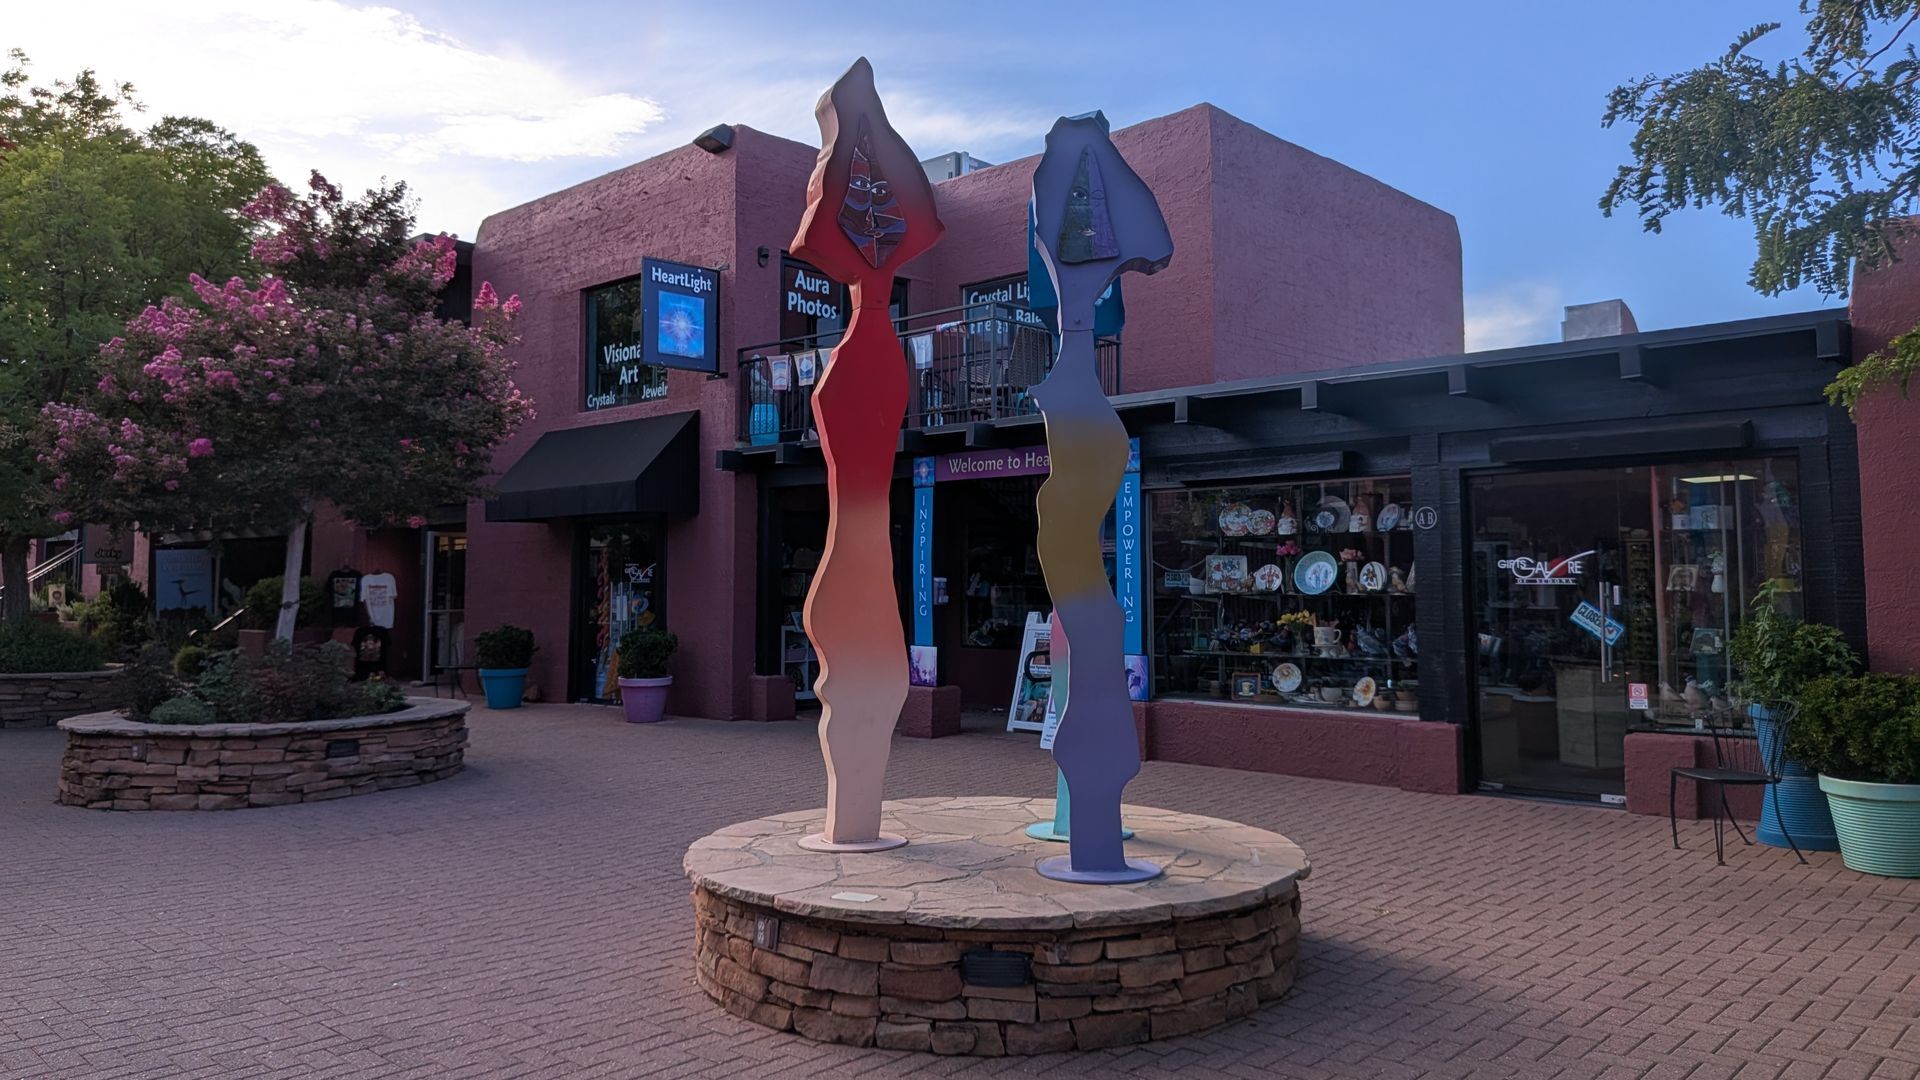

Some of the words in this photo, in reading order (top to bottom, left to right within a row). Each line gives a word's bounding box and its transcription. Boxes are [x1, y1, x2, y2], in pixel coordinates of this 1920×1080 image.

[651, 266, 713, 293] HeartLight
[794, 269, 831, 295] Aura
[787, 291, 837, 320] Photos
[618, 365, 639, 386] Art
[586, 390, 616, 410] Crystals
[949, 455, 1004, 474] Welcome
[1007, 453, 1021, 470] to
[918, 495, 928, 617] INSPIRING
[1122, 481, 1135, 623] EMPOWERING
[1497, 559, 1527, 569] GIFTS
